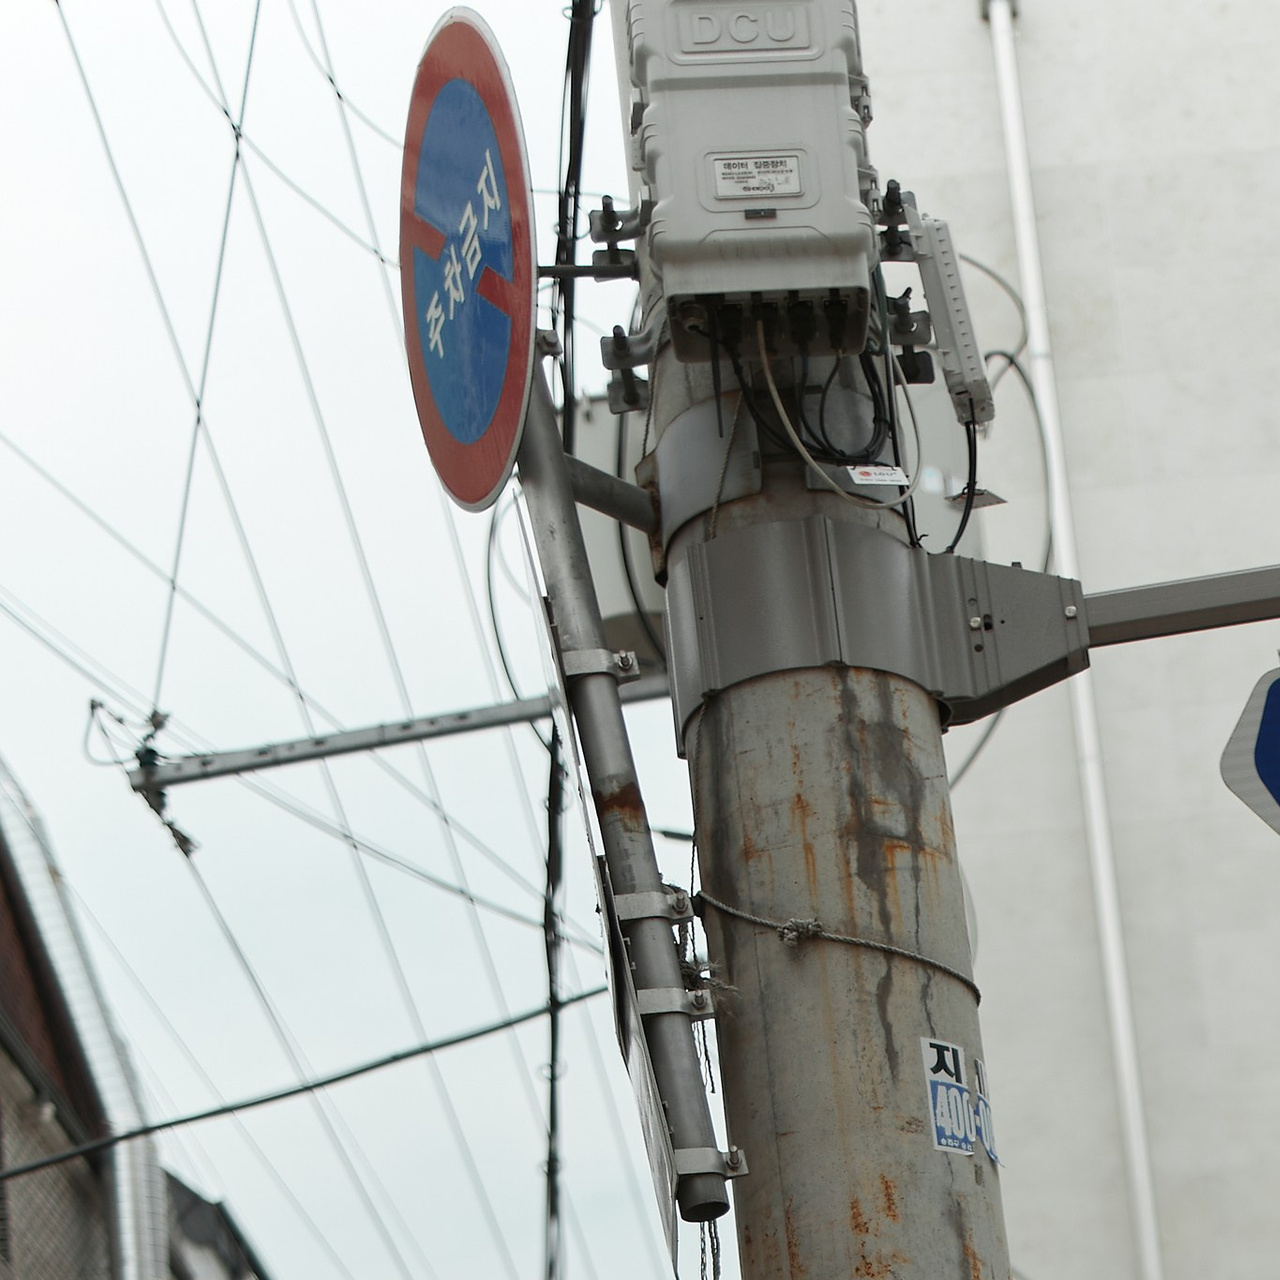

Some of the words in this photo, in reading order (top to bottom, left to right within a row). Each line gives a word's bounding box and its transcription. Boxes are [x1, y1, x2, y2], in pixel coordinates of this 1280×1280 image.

[692, 9, 796, 45] DCU
[723, 161, 748, 170] 데이터
[754, 159, 787, 169] 집중장치
[427, 149, 501, 359] 주차금지
